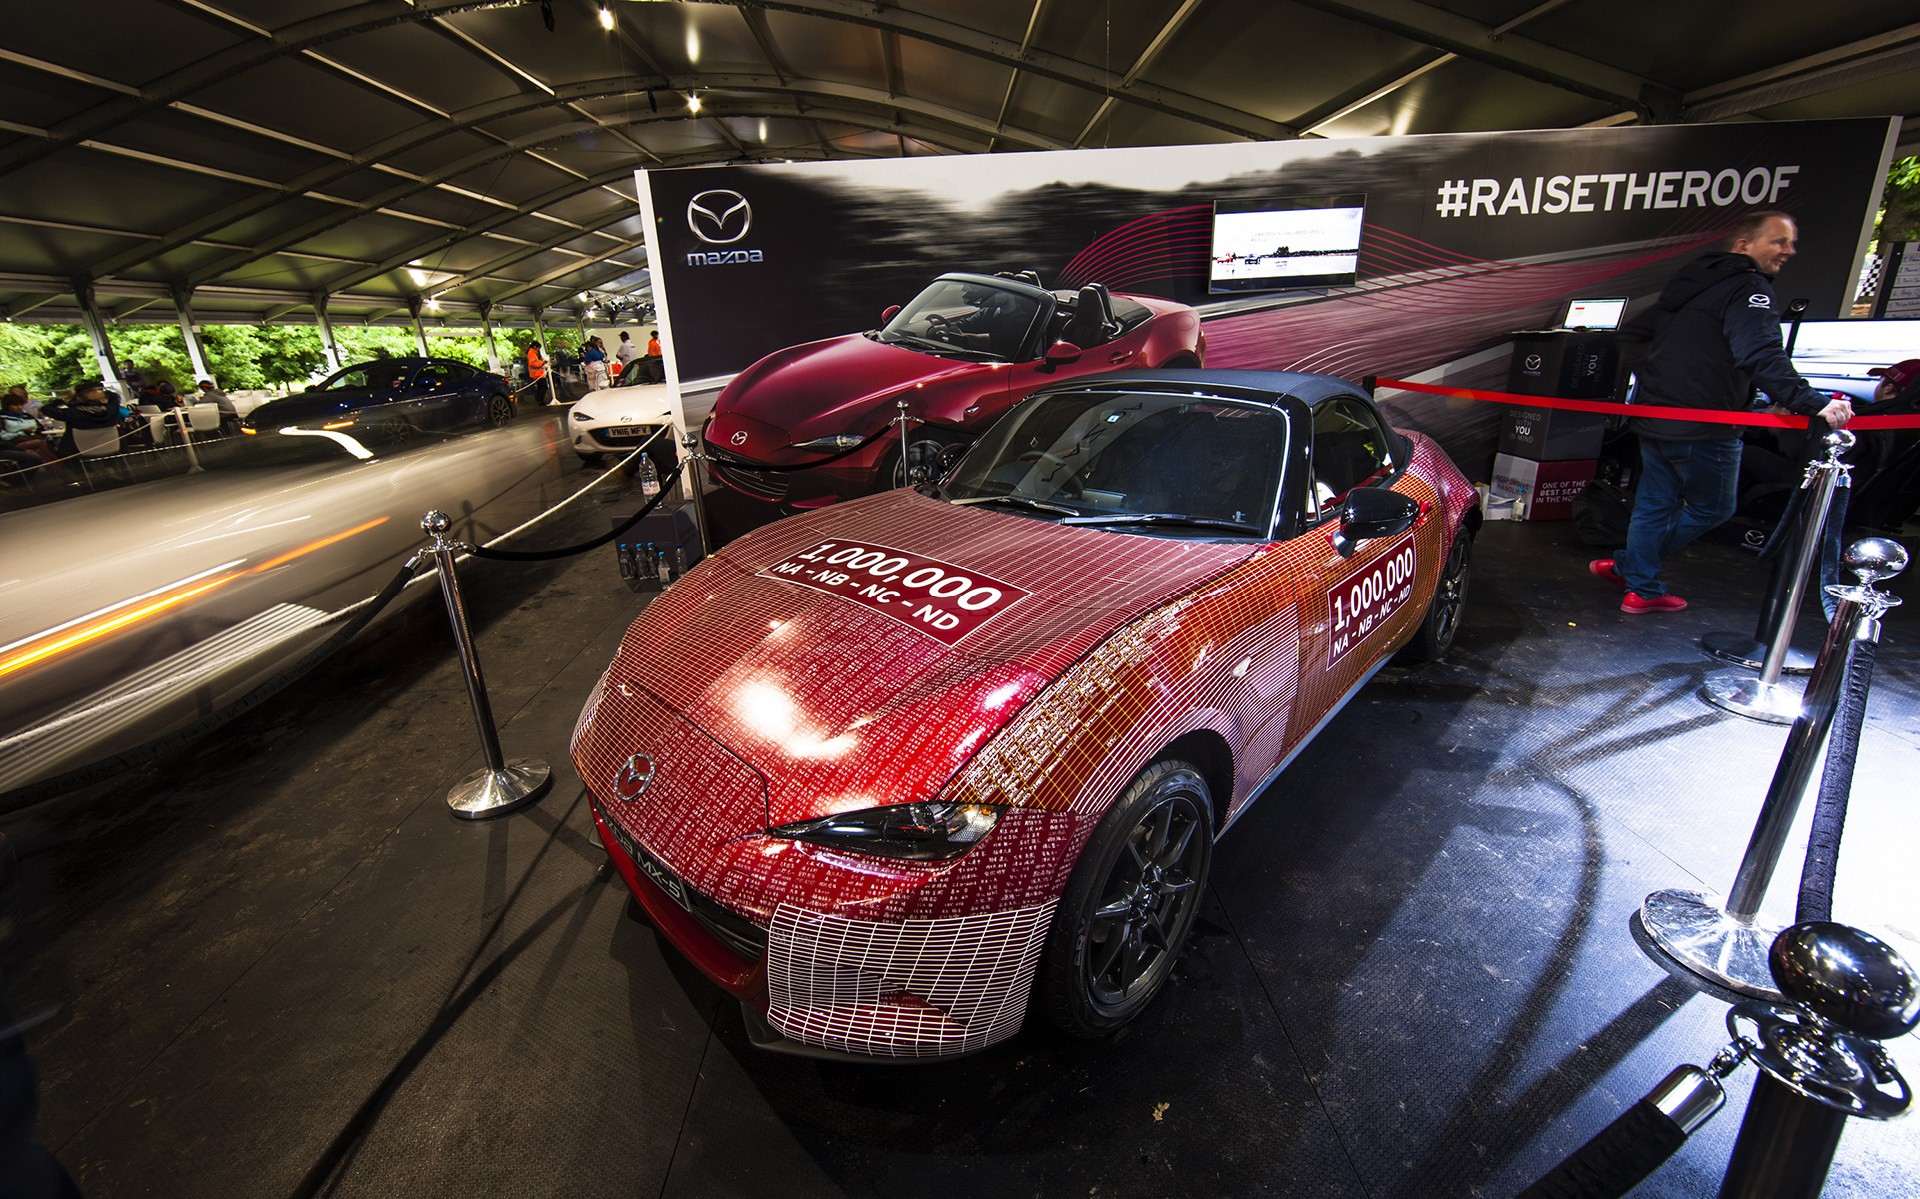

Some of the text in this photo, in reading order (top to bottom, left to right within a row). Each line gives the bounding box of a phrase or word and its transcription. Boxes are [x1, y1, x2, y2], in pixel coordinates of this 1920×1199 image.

[1435, 165, 1800, 218] #RAISETHEROOF
[1586, 354, 1598, 377] YOU
[1509, 409, 1542, 422] DESIGNED
[1515, 418, 1532, 427] WITH
[1515, 425, 1531, 436] YOU
[1517, 434, 1534, 444] MIND
[1540, 488, 1560, 497] BEST
[797, 543, 1002, 611] 1,000,000
[1334, 547, 1414, 632] 1,000,000
[772, 562, 800, 576] NA
[811, 569, 850, 587] NB
[857, 583, 901, 604] NC
[911, 604, 960, 630] ND
[1333, 633, 1349, 658] NA
[1357, 614, 1373, 637] NB
[1379, 597, 1393, 619] NC
[1397, 584, 1411, 604] ND
[637, 851, 681, 899] MX-5
